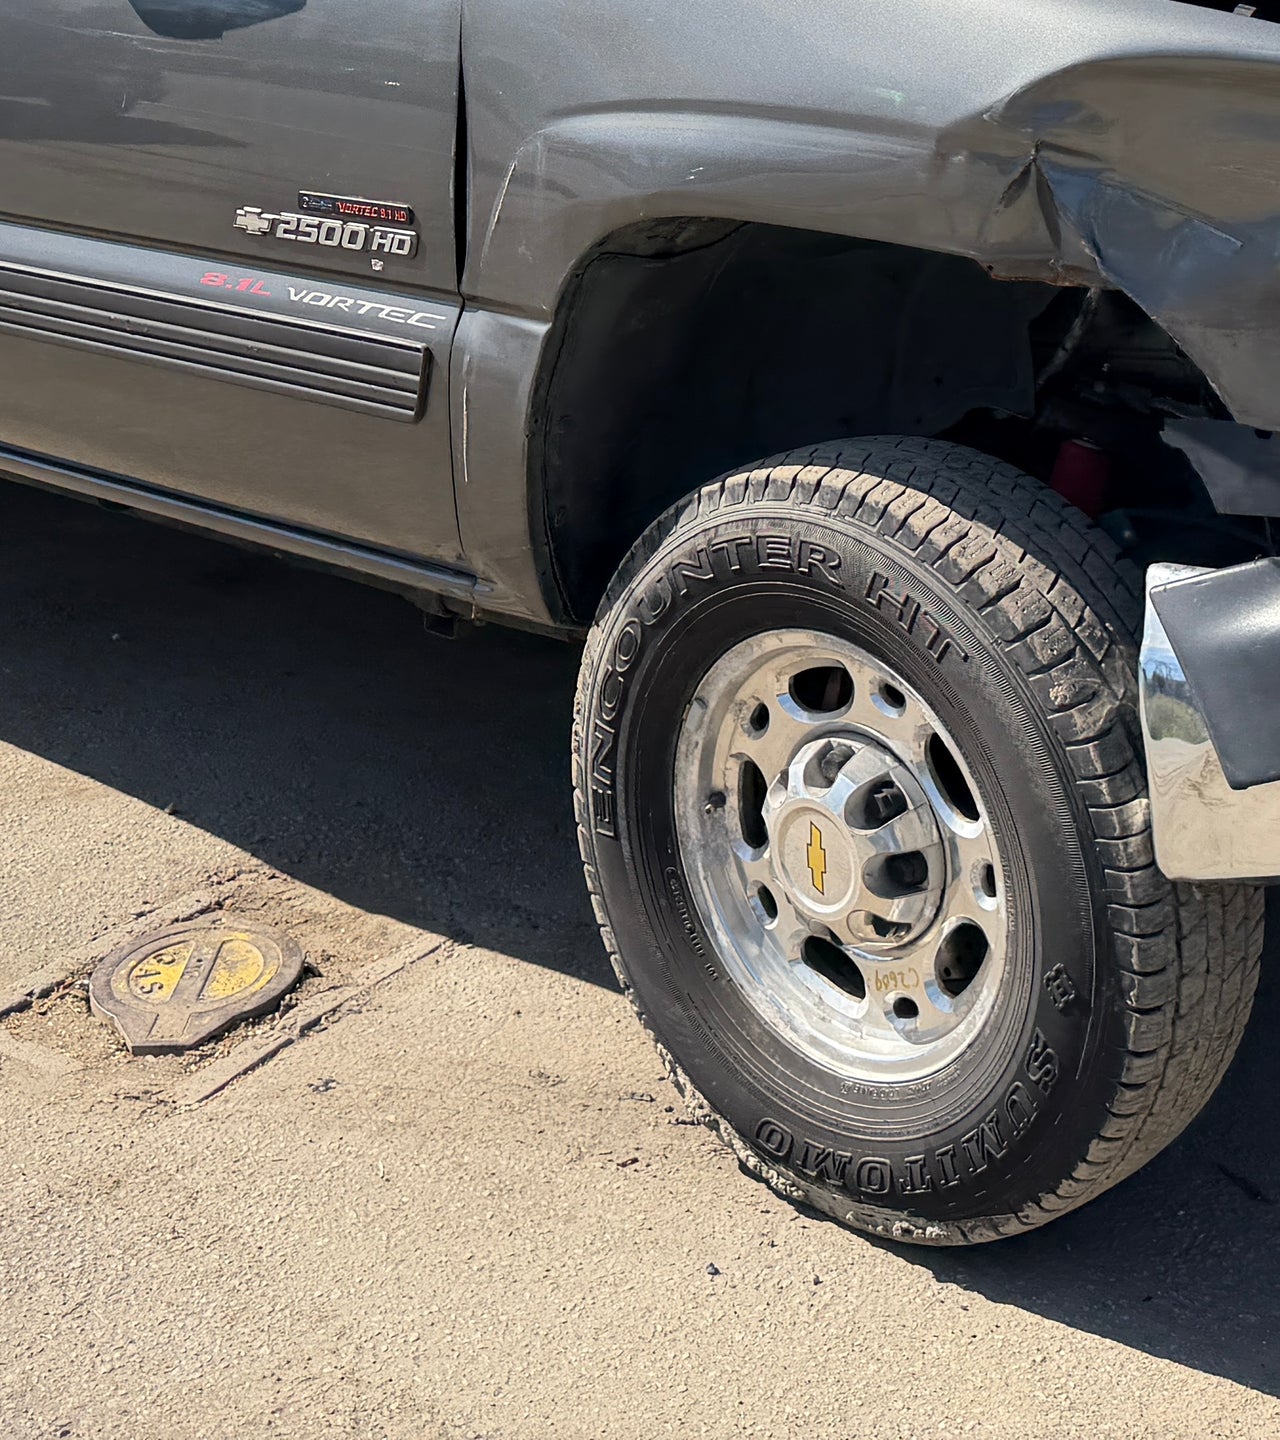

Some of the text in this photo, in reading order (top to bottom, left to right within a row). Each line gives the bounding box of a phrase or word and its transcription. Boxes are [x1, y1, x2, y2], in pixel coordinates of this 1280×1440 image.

[275, 214, 412, 256] 2500 HD
[200, 271, 447, 329] 8.1L VORTEC
[592, 528, 846, 840] ENCOUNTER
[755, 1026, 1060, 1196] SUMITOMO
